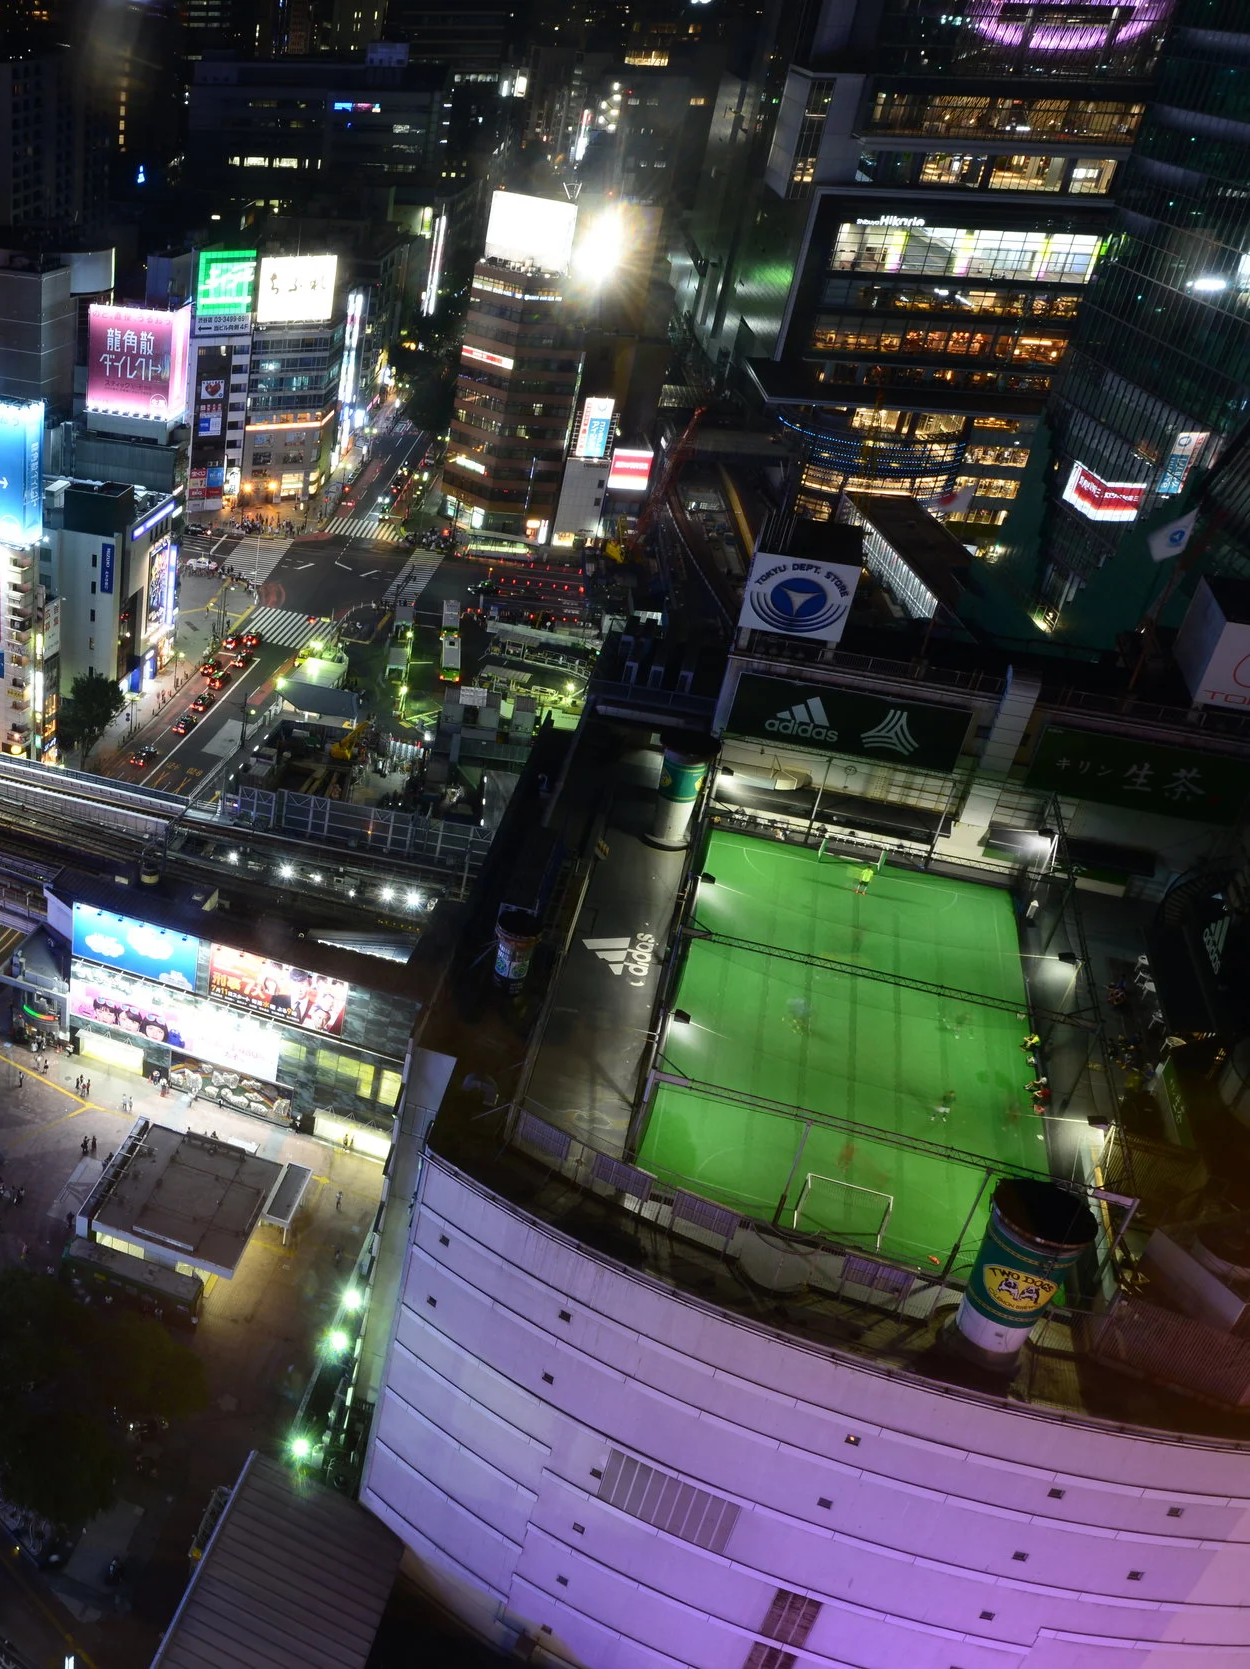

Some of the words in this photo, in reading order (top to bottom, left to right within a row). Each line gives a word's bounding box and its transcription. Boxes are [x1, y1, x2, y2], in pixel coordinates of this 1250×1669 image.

[856, 218, 880, 226] Shibuya
[880, 215, 925, 227] Hikarie
[269, 272, 326, 295] ちふれ
[106, 327, 155, 356] 龍角散
[99, 353, 162, 382] ダイレクト
[754, 564, 787, 585] TOKYU
[792, 563, 821, 574] DEPT.
[824, 571, 850, 598] STORE
[765, 717, 839, 743] adidas
[1056, 757, 1113, 776] キリン
[1122, 762, 1207, 802] 生茶
[212, 972, 266, 999] 刑事7人
[988, 1267, 1021, 1281] TWO
[1022, 1275, 1054, 1293] DOGS
